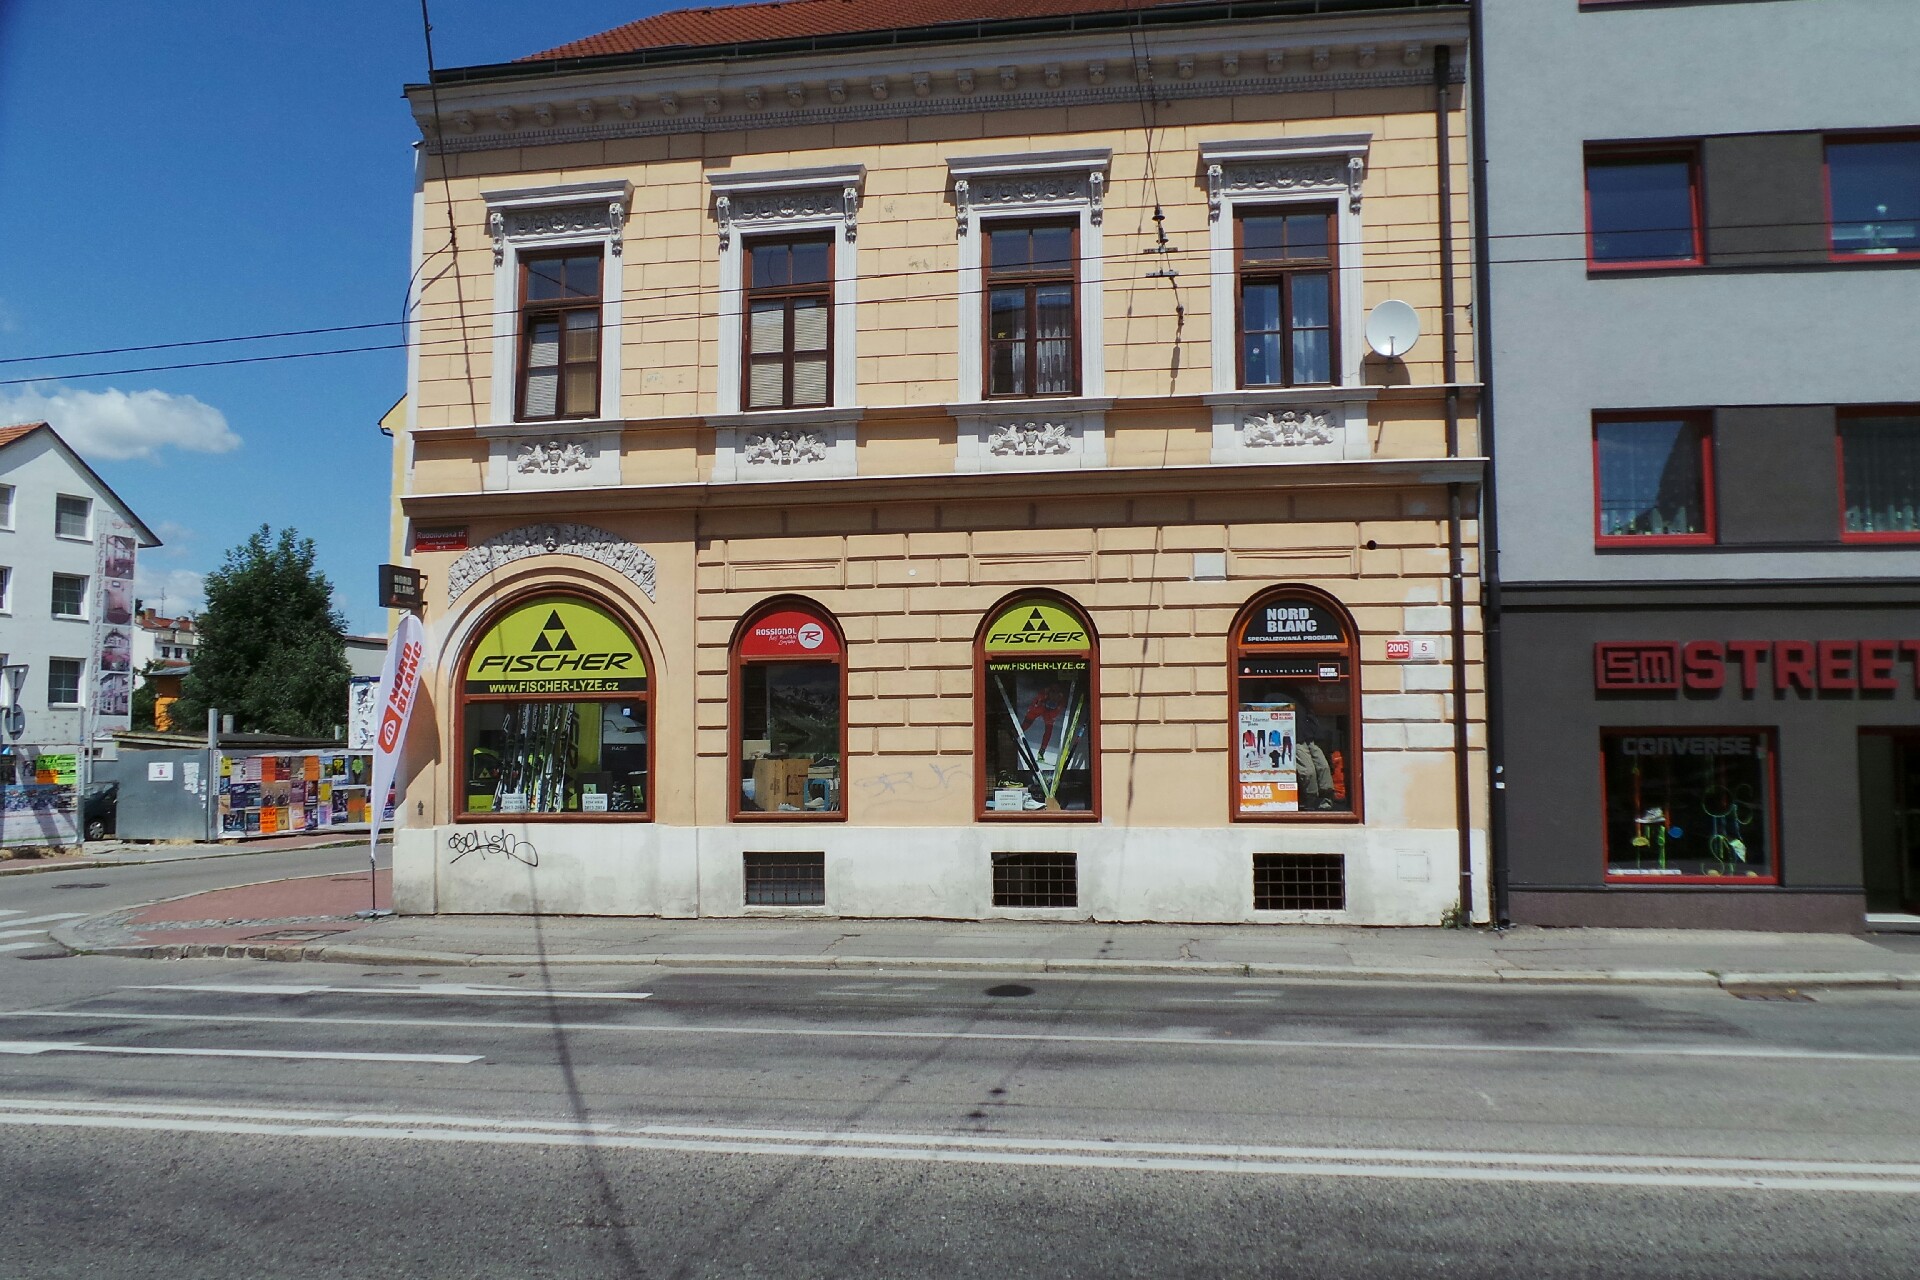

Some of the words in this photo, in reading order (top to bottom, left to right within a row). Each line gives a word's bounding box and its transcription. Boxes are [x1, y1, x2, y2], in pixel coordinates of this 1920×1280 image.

[394, 574, 412, 586] NORD
[394, 584, 415, 595] BLANC
[1266, 608, 1310, 620] NORD
[755, 628, 797, 636] ROSSIGNOL
[1267, 620, 1317, 632] BLANC
[989, 632, 1084, 643] FISCHER
[1387, 643, 1409, 653] 2005
[1421, 642, 1428, 652] 5
[477, 652, 633, 673] FISCHER
[989, 662, 1086, 671] www.FISCHER-LYZE.cz
[389, 642, 414, 706] NORD
[396, 641, 422, 715] BLANC
[489, 680, 619, 693] www.FISCHER-LYZE.cz
[1622, 737, 1751, 755] CONVERSE
[1242, 784, 1272, 794] NOVÁ
